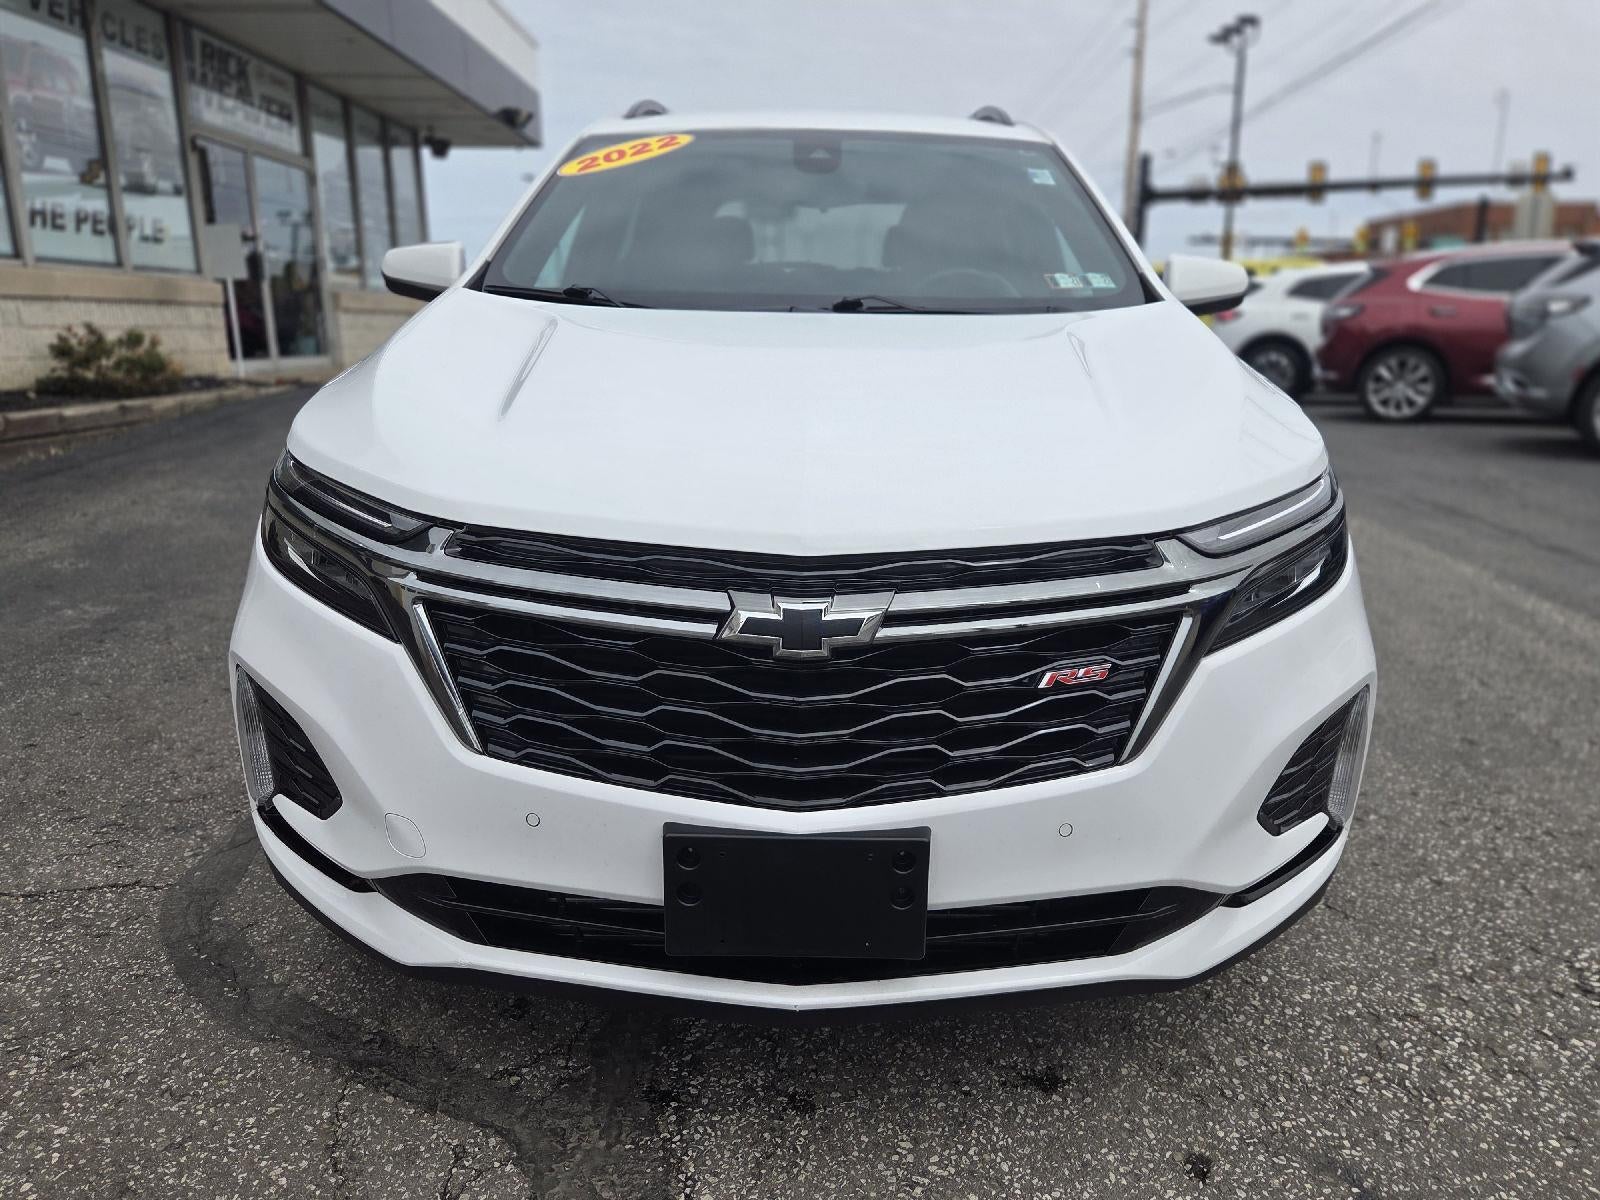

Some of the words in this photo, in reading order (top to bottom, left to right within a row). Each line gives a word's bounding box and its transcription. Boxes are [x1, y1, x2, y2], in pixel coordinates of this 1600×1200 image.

[29, 0, 165, 61] EHCLES
[575, 134, 682, 173] 2022
[29, 200, 66, 232] HE
[1038, 663, 1112, 689] RS
